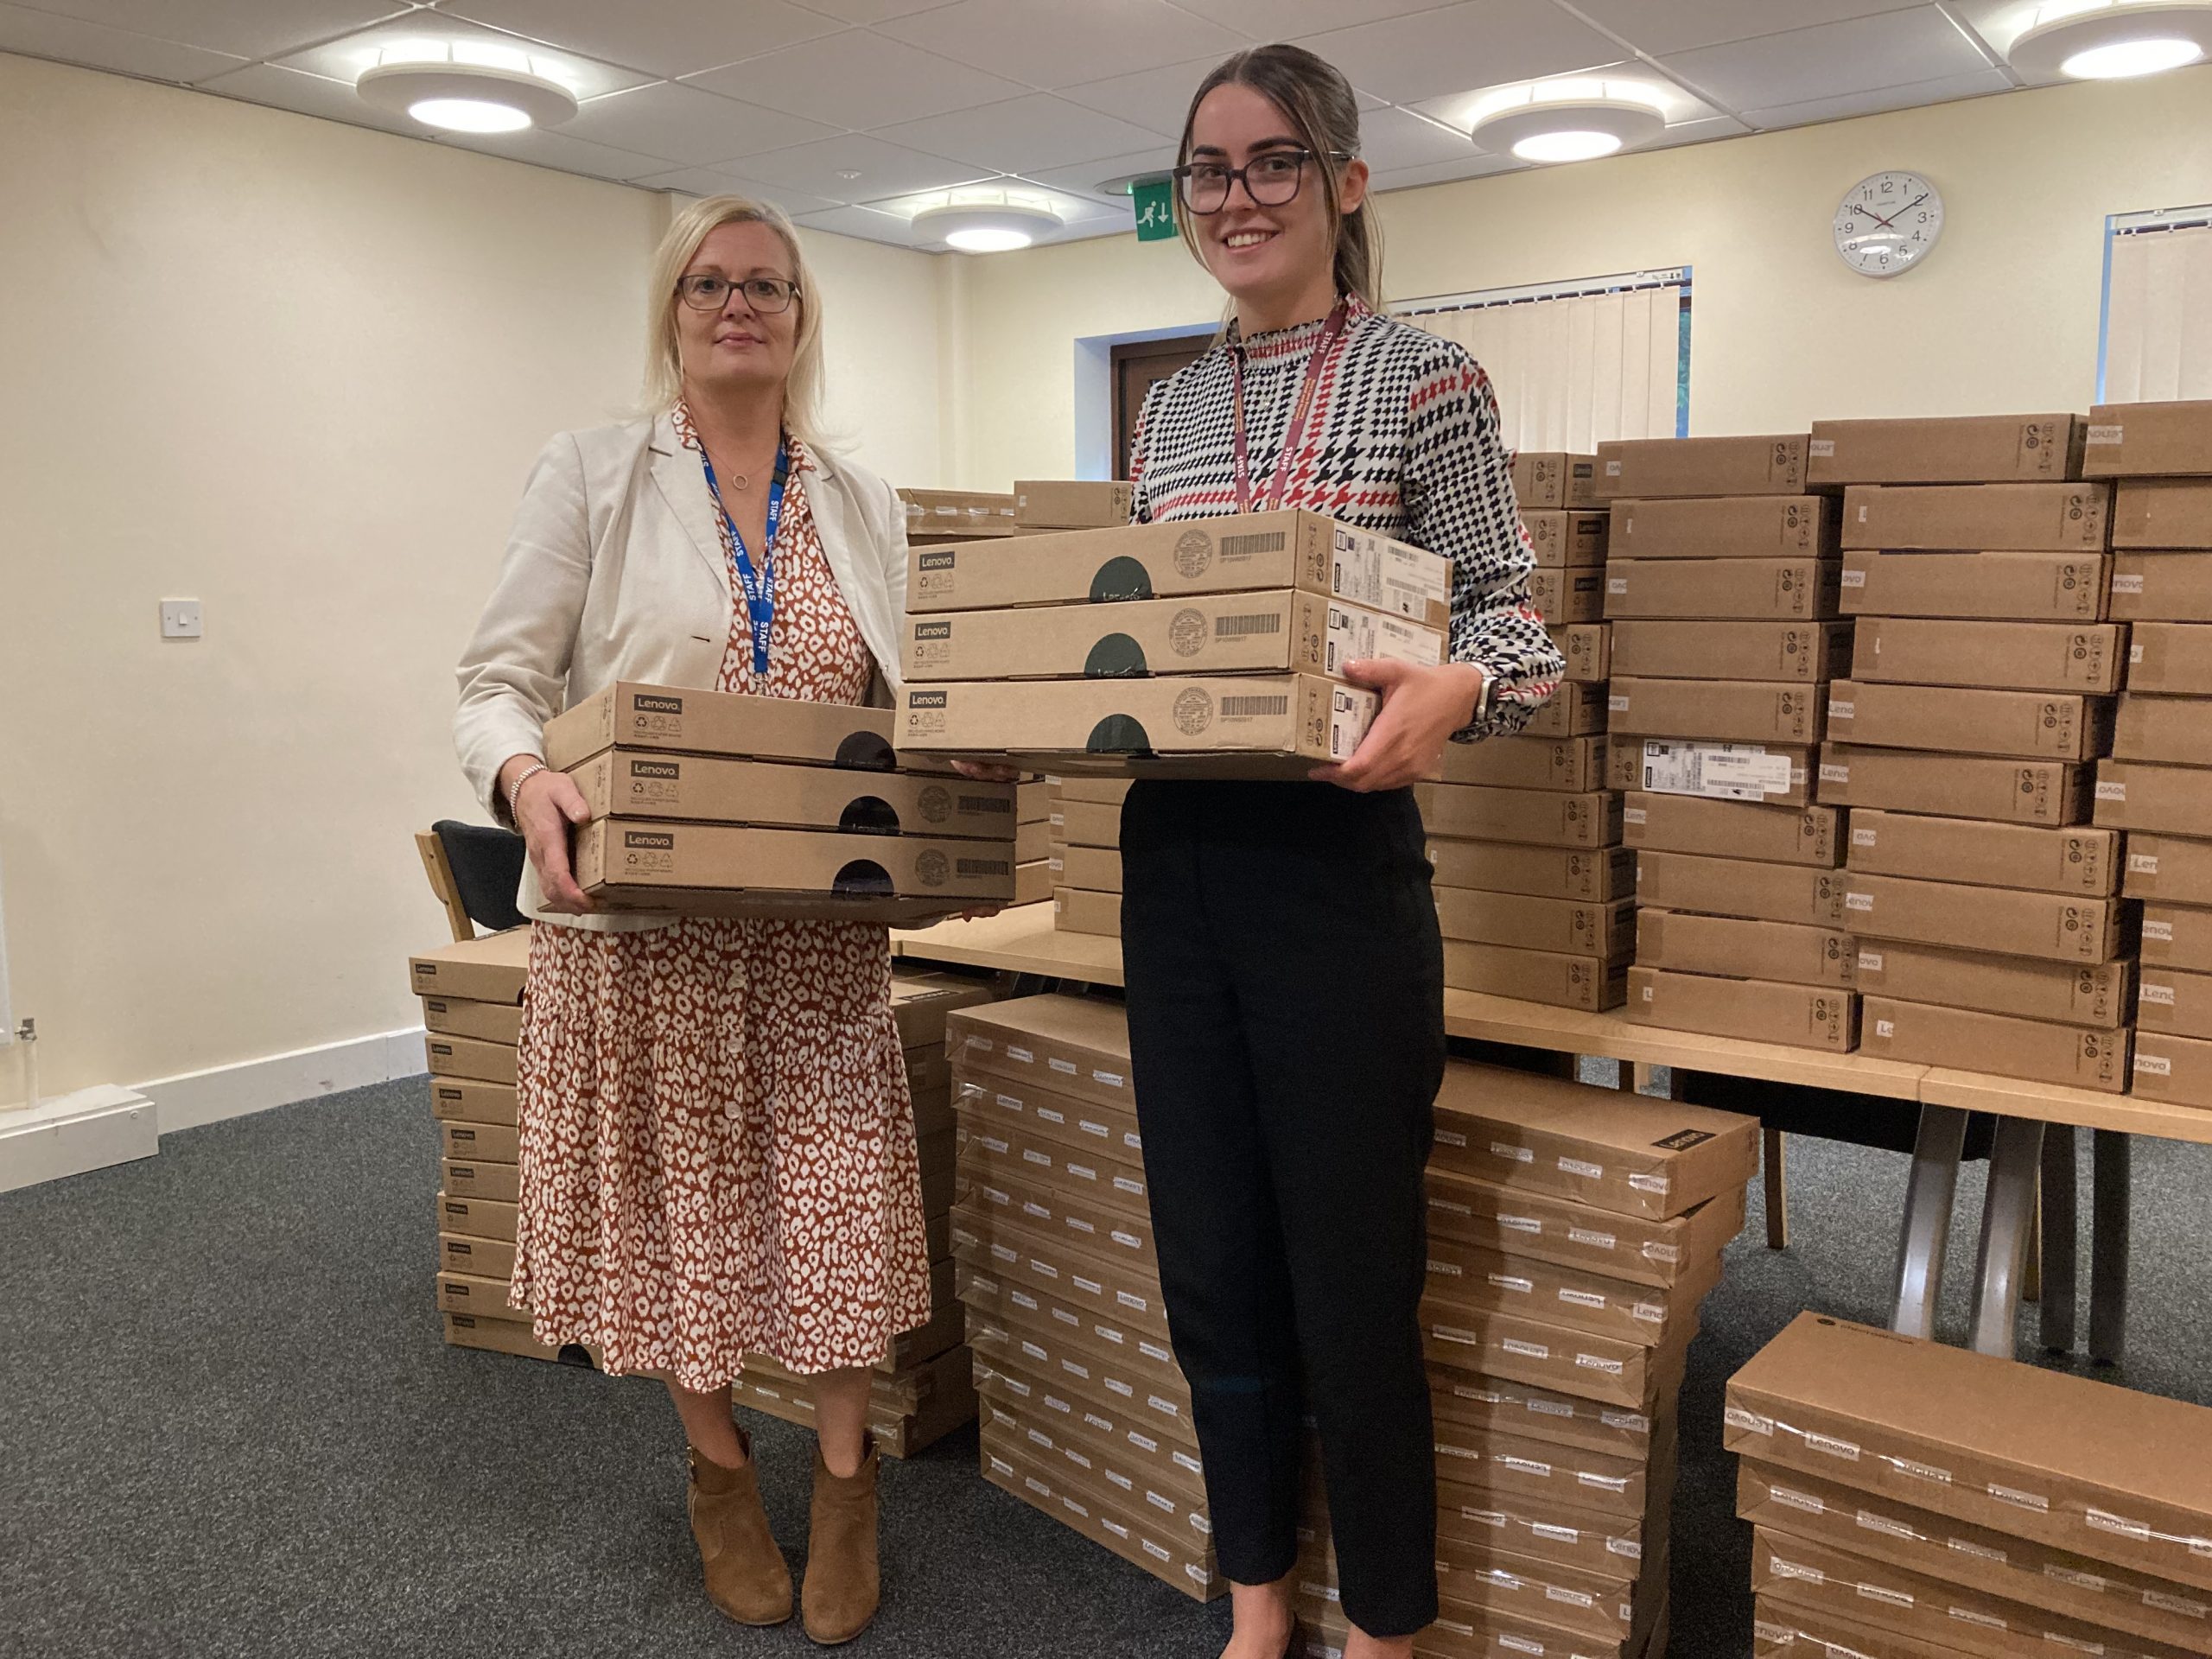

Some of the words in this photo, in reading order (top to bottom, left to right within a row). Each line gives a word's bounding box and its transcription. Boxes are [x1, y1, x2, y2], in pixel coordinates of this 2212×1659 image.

[1880, 181, 1893, 194] 12
[1904, 183, 1908, 195] 1
[1863, 188, 1873, 200] 11
[1914, 194, 1923, 207] 2
[1849, 203, 1863, 216] 10
[1917, 212, 1927, 224] 3
[1845, 222, 1853, 233] 9
[1911, 230, 1920, 242] 4
[1898, 245, 1908, 257] 5
[1879, 253, 1889, 264] 6
[1319, 331, 1333, 354] STAFF
[1280, 446, 1294, 472] STAFF
[769, 499, 779, 521] STAFF
[921, 556, 953, 568] Lenovo
[742, 573, 757, 601] STAFF
[764, 576, 774, 605] STAFF
[759, 621, 769, 652] STAFF
[918, 626, 948, 637] Lenovo
[638, 697, 678, 710] Lenovo
[912, 694, 944, 705] Lenovo
[635, 764, 676, 776] Lenovo
[628, 835, 670, 846] Lenovo
[1579, 1357, 1620, 1371] Lenovo
[1808, 1436, 1855, 1456] Lenovo
